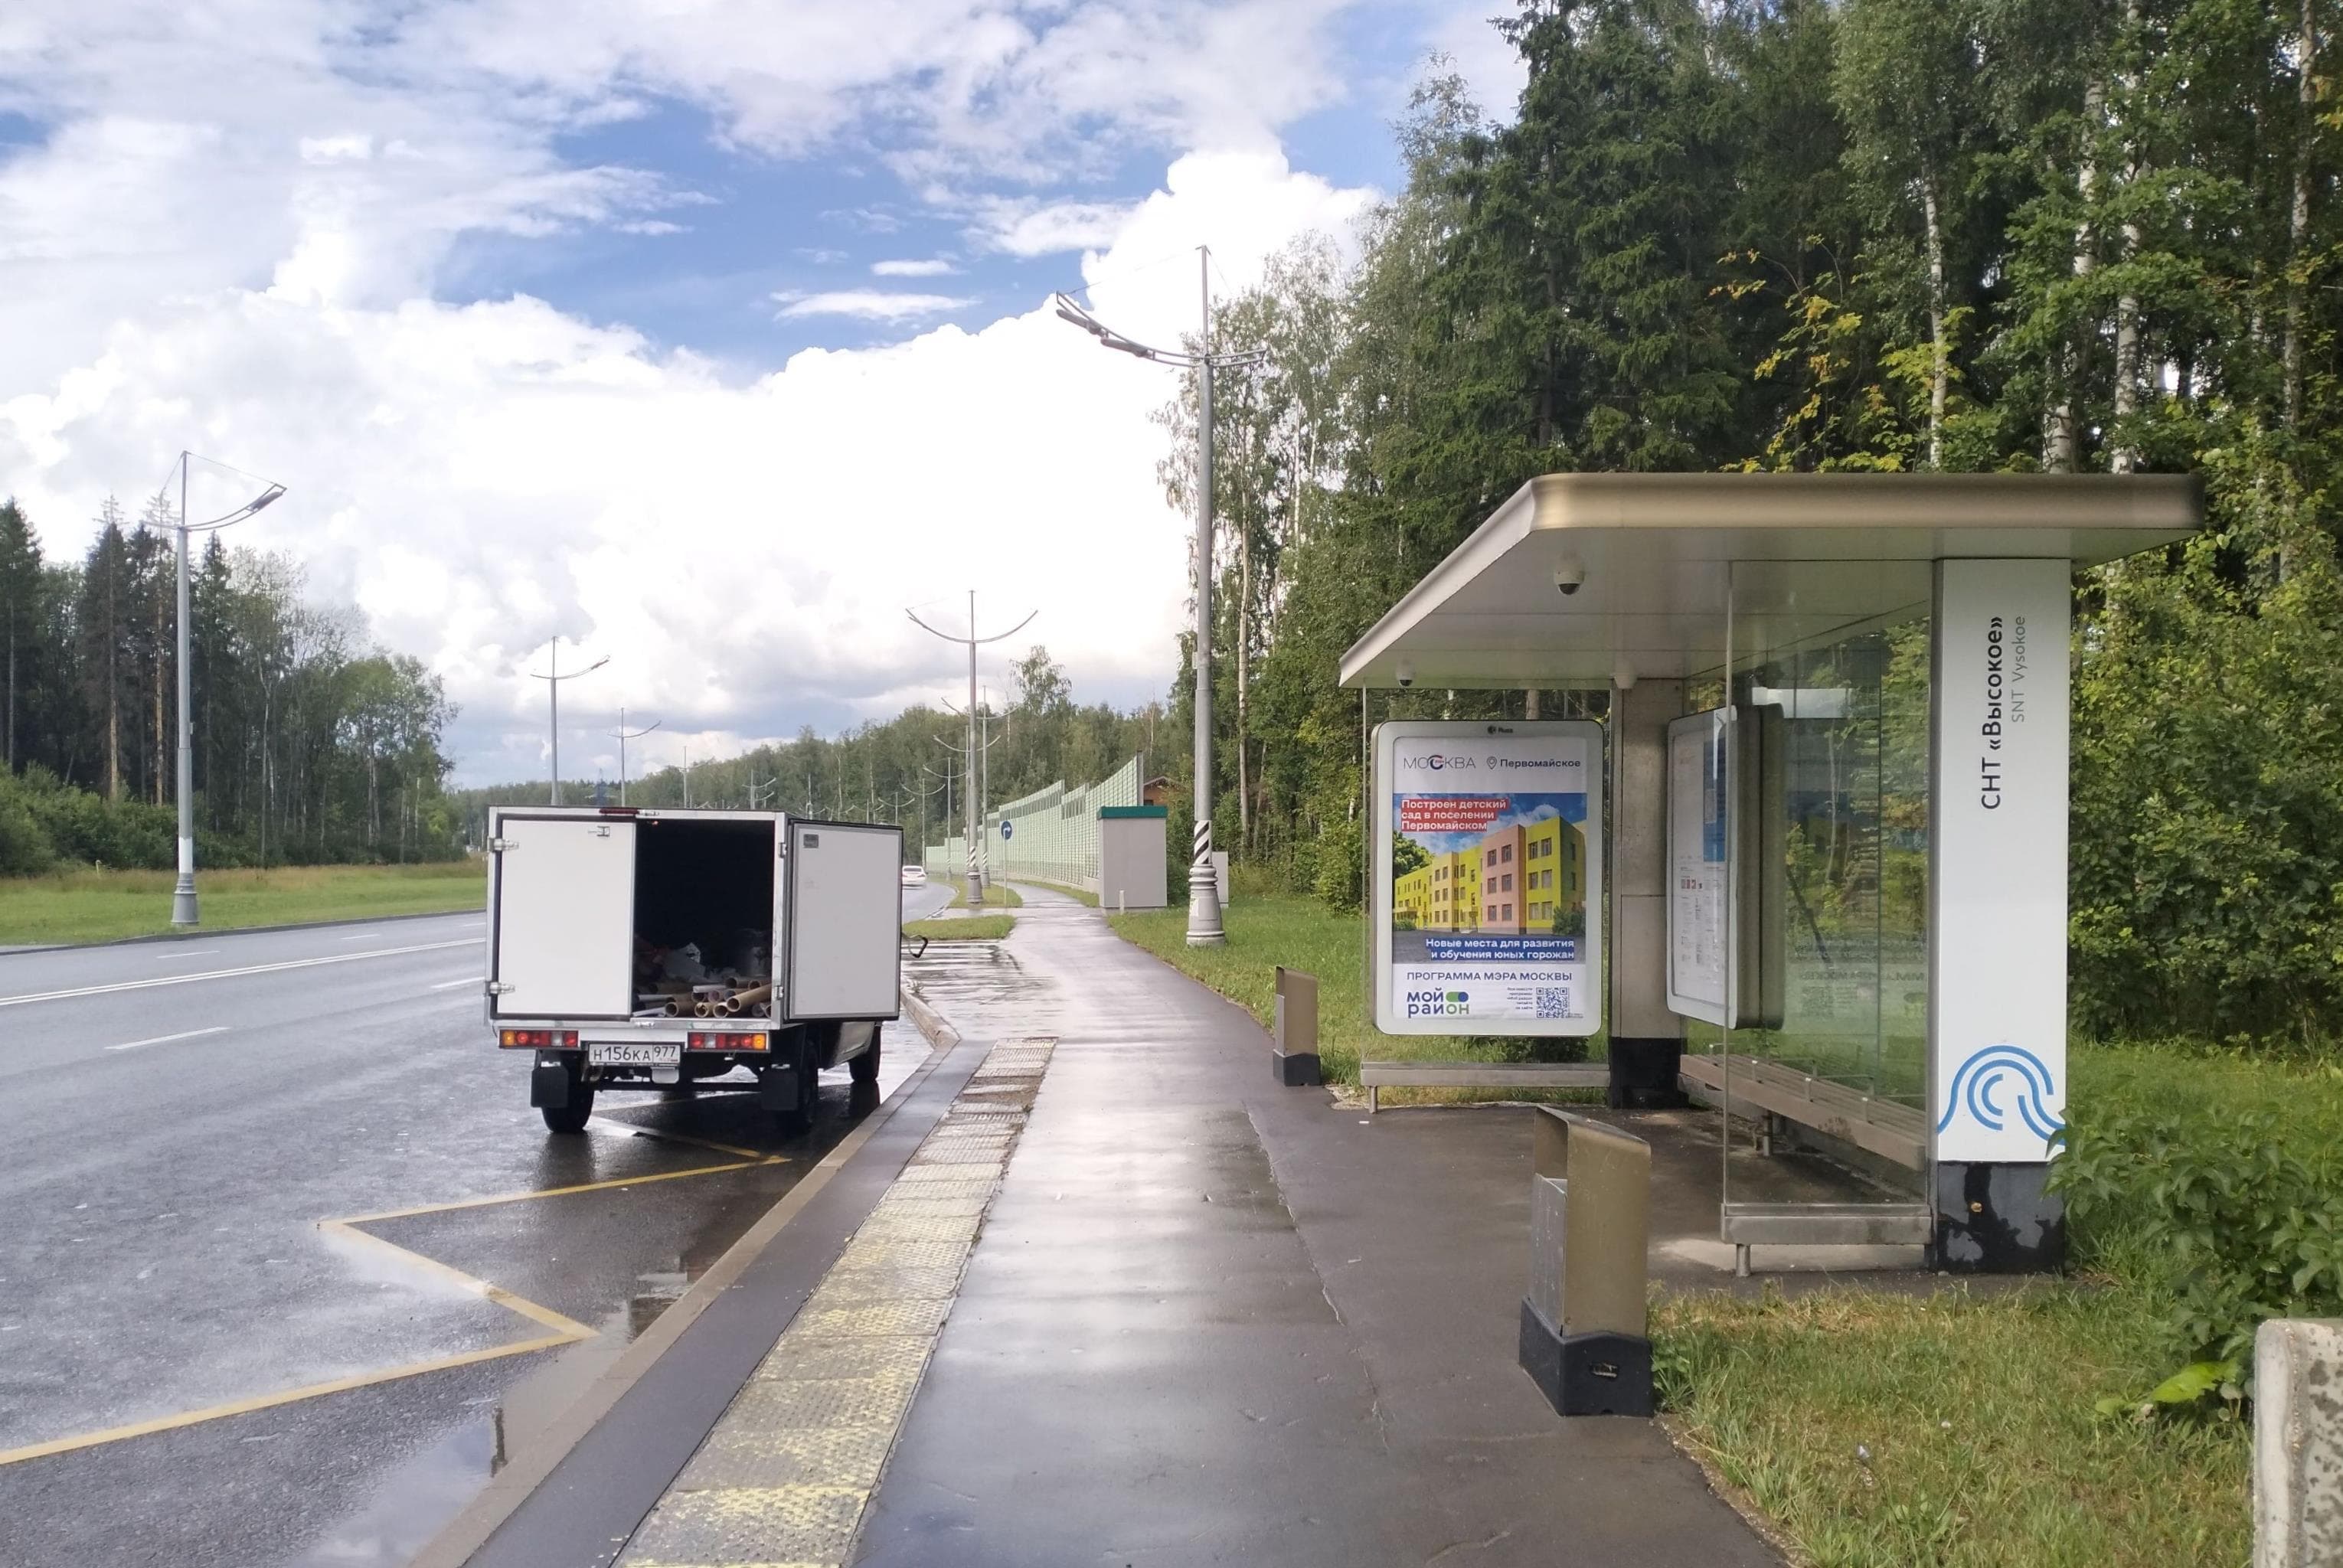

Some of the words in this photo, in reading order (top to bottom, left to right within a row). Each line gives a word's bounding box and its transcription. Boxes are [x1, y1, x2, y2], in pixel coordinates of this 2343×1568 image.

[2011, 616, 2028, 681] Vysokoe
[1982, 616, 2003, 750] «Высокое»
[2011, 690, 2024, 723] SNT
[1404, 754, 1476, 769] МОСКВА
[1500, 758, 1581, 769] Первомайское
[1981, 756, 2001, 809] СНТ
[1401, 799, 1456, 810] Построен
[1459, 799, 1506, 809] детский
[1401, 812, 1422, 820] сад
[1401, 821, 1487, 831] Первомайском
[1426, 938, 1462, 948] Новые
[1500, 940, 1520, 949] для
[1523, 940, 1574, 949] развития
[1440, 950, 1492, 960] обучения
[1527, 951, 1574, 960] горожан
[1407, 972, 1481, 981] ПРОГРАММА
[1484, 972, 1517, 981] МЭРА
[1519, 972, 1572, 981] МОСКВЫ
[1407, 987, 1444, 1002] мой
[593, 1046, 651, 1060] Н156КА
[654, 1046, 676, 1057] 977
